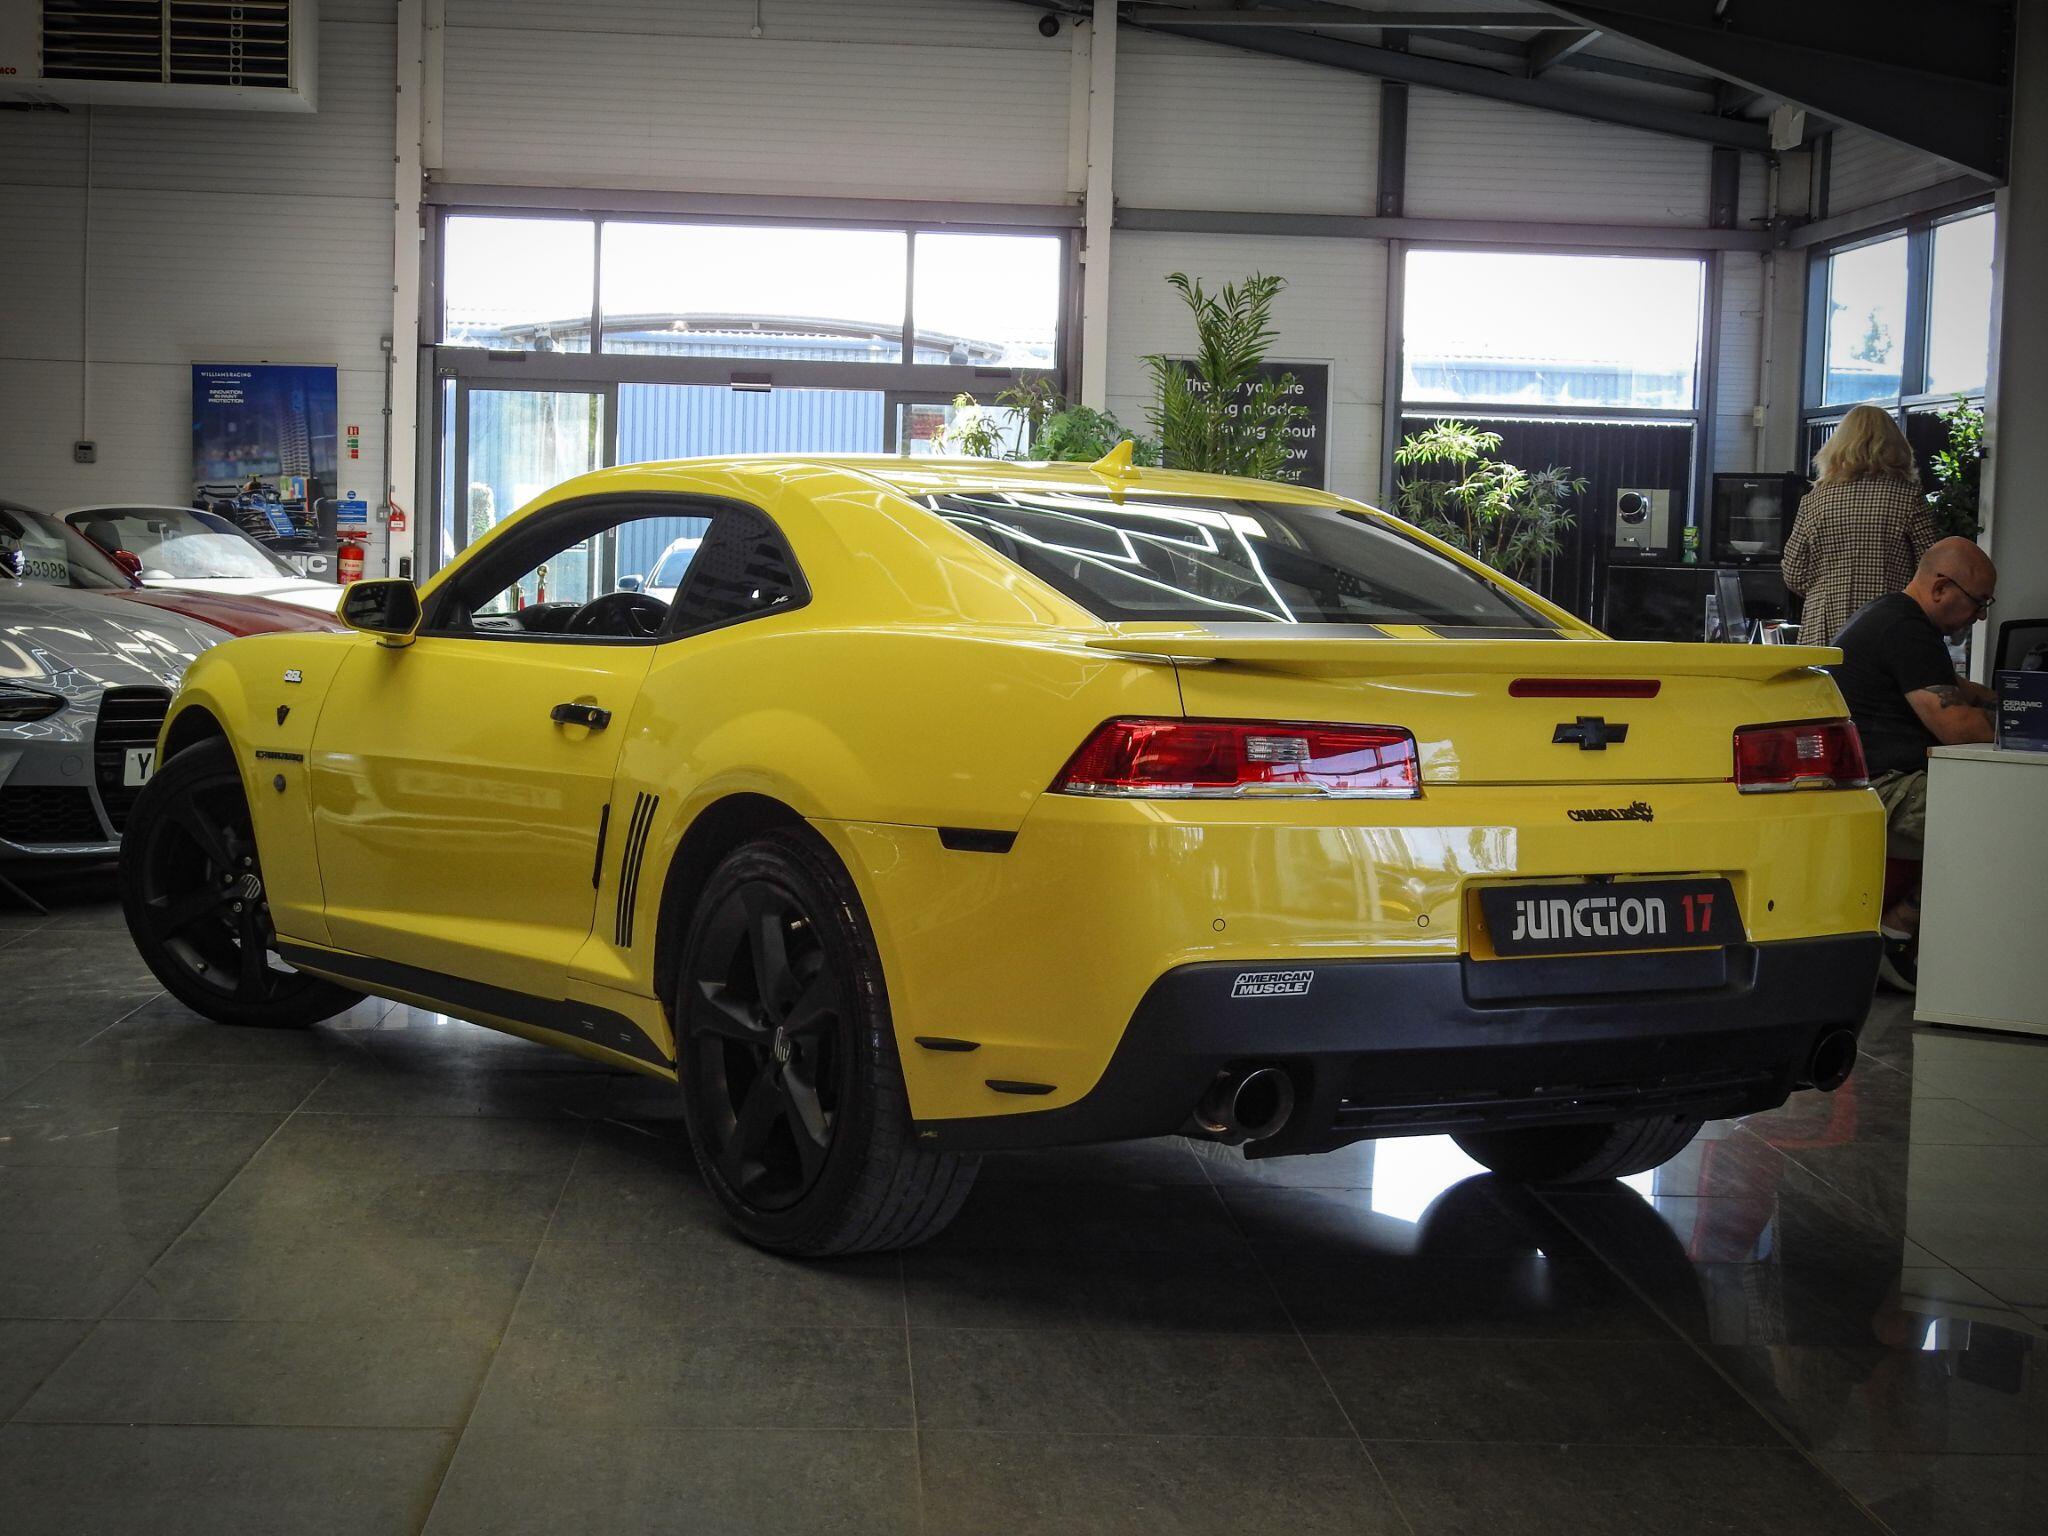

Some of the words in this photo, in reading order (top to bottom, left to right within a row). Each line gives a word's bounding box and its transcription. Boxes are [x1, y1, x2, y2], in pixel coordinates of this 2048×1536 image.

[1185, 378, 1211, 392] The
[2003, 699, 2043, 709] CERAMIC
[1681, 893, 1714, 933] 17
[1238, 971, 1312, 984] AMERICAN
[1239, 982, 1305, 995] MUSCLE
